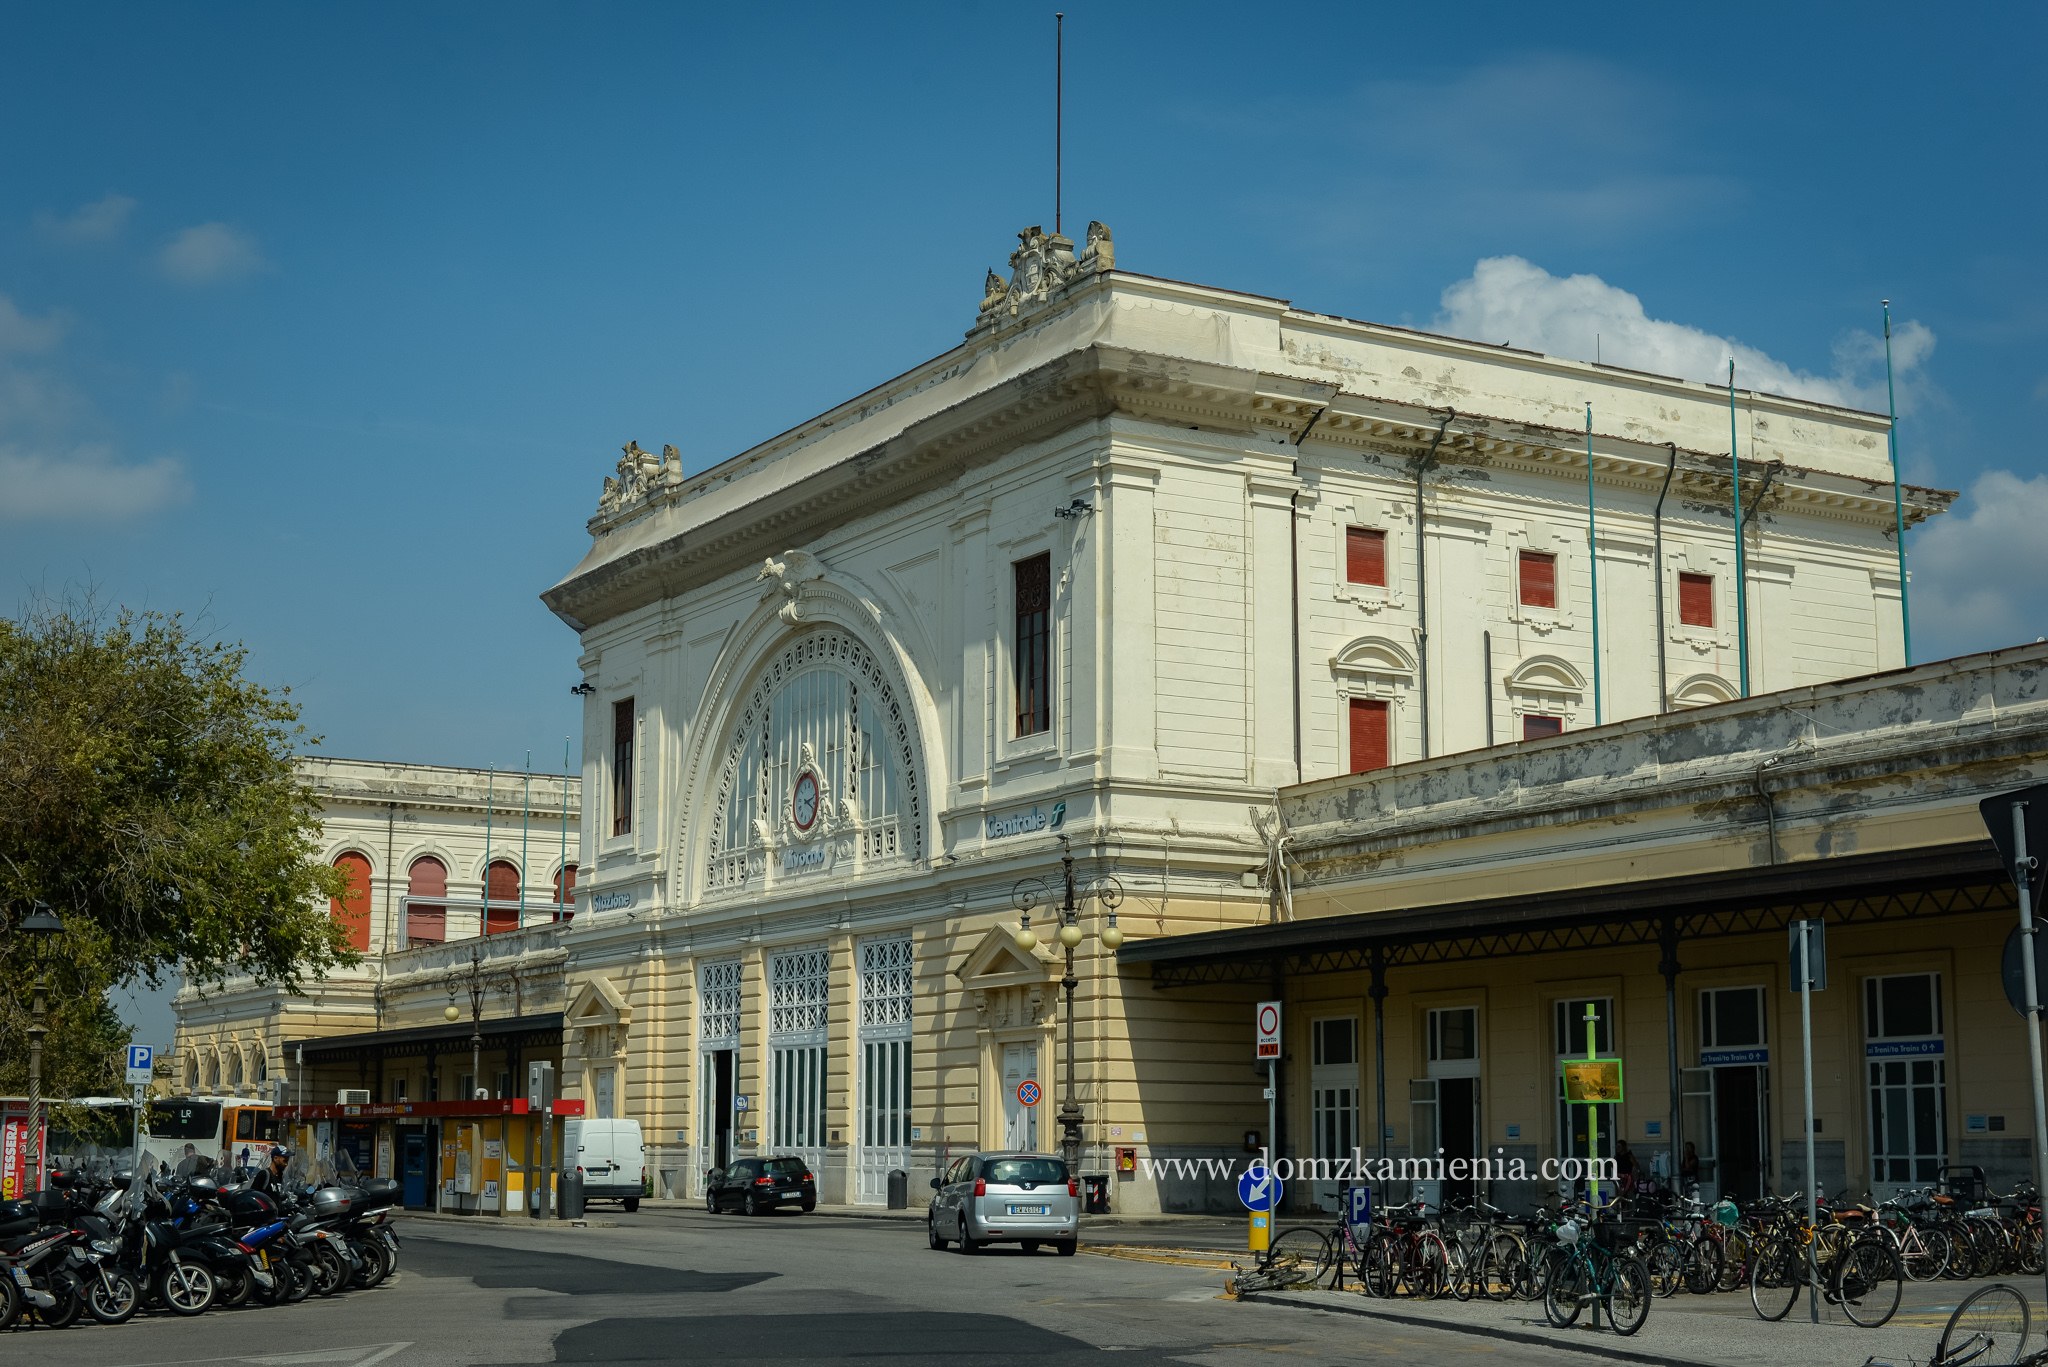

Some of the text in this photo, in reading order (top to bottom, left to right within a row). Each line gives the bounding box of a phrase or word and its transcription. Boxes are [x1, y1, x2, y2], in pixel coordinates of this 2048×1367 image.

[986, 805, 1046, 840] Centrale
[594, 892, 631, 912] Stazione
[1260, 1045, 1278, 1055] TAXI
[1900, 1044, 1920, 1052] Trains
[134, 1048, 149, 1067] P
[1730, 1053, 1747, 1061] Trains
[181, 1109, 192, 1118] LR
[1354, 1188, 1366, 1221] P
